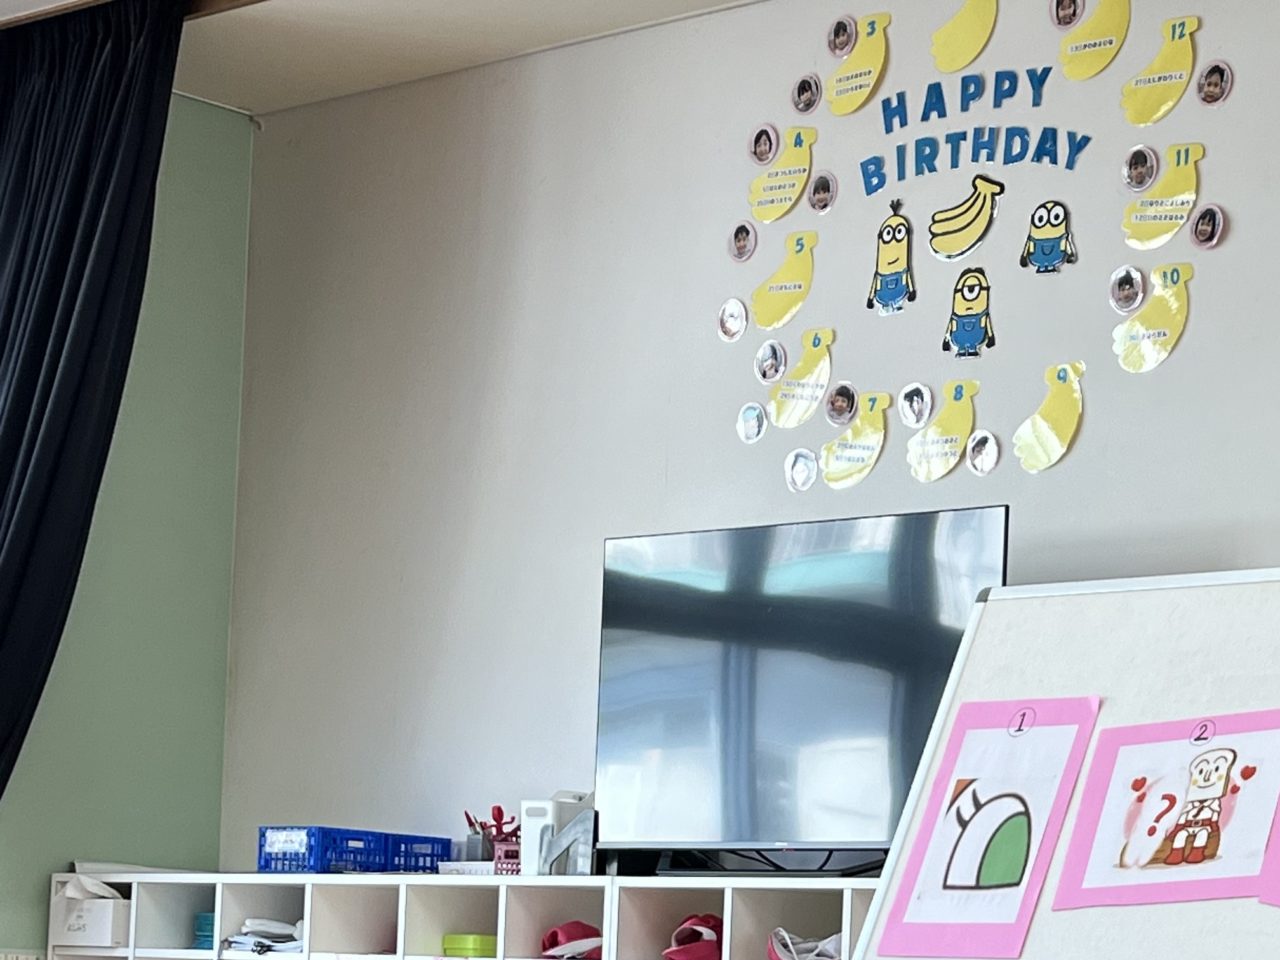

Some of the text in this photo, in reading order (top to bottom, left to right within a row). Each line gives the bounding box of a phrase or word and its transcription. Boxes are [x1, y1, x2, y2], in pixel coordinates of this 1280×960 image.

[866, 19, 877, 37] 3
[1170, 21, 1187, 42] 12
[881, 66, 1054, 135] HAPPY
[793, 130, 804, 149] 4
[860, 126, 1093, 196] BIRTHDAY
[1176, 147, 1190, 167] 11
[794, 236, 806, 255] 5
[1162, 267, 1180, 288] 10
[812, 332, 822, 348] 6
[1056, 367, 1068, 384] 9
[953, 384, 964, 402] 8
[867, 396, 878, 413] 7
